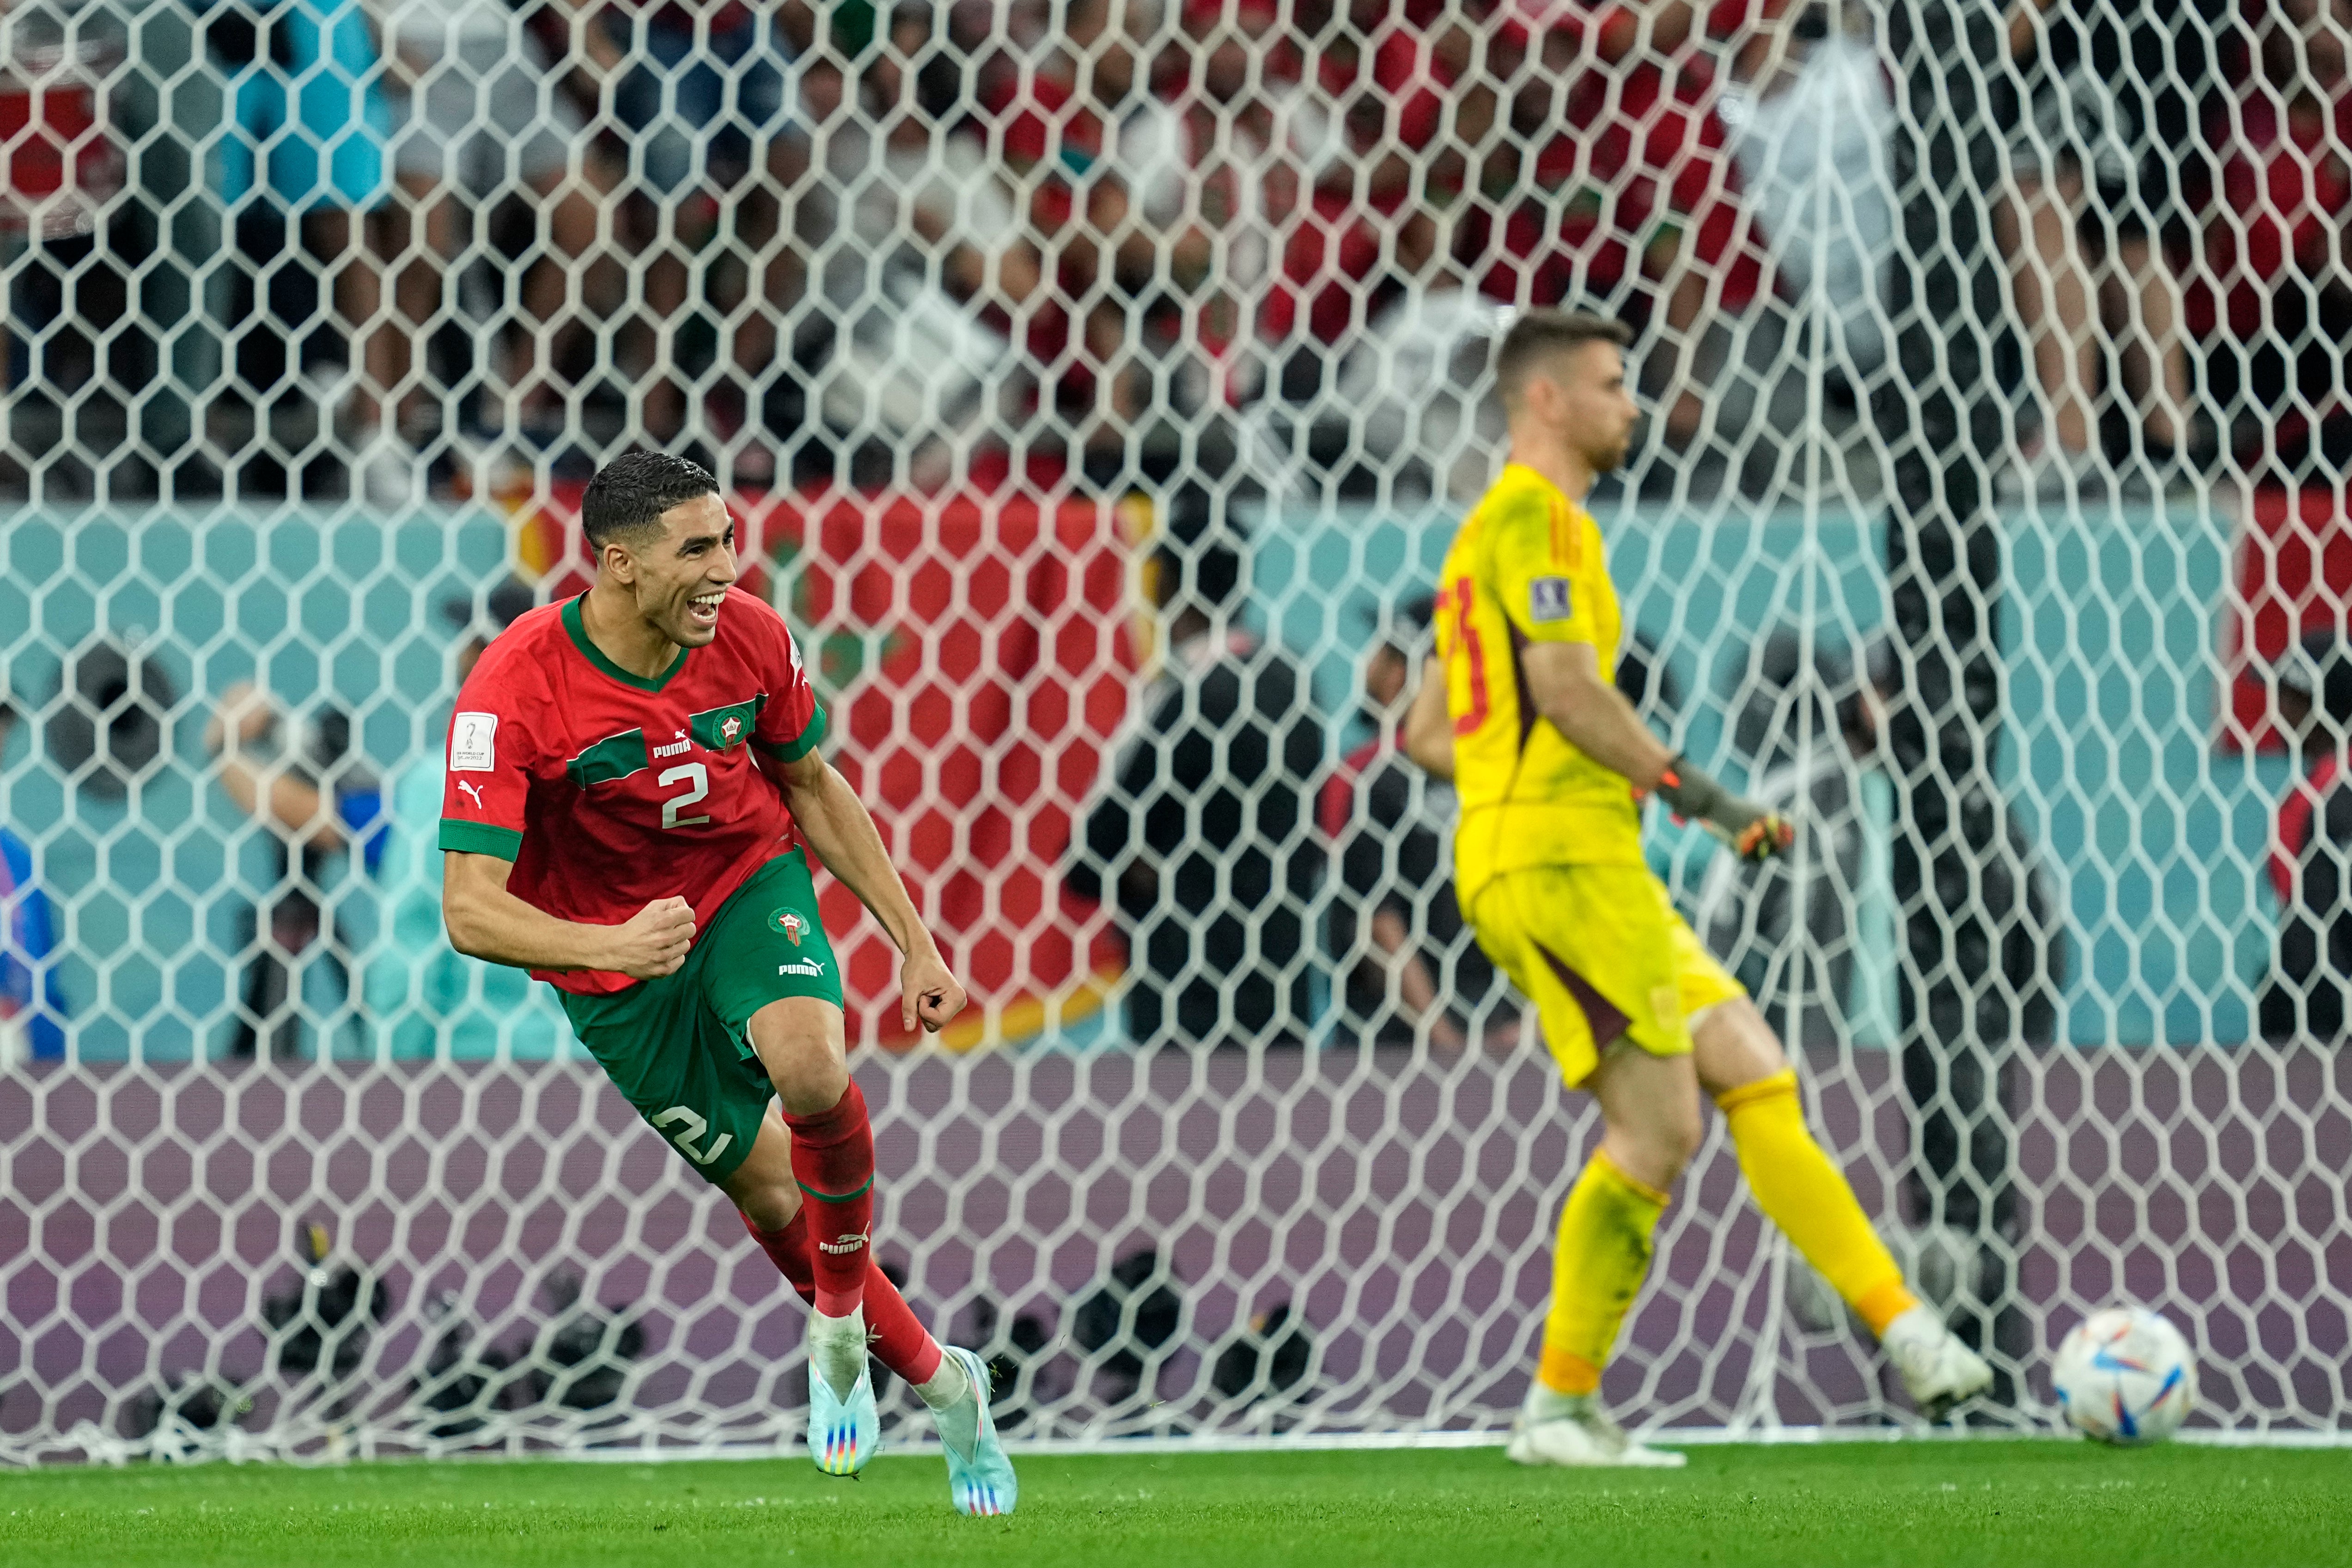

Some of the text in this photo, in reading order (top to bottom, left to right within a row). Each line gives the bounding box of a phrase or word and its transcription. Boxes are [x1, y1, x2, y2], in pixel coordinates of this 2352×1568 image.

[653, 739, 691, 758] PUMA
[658, 762, 710, 829] 2
[779, 964, 817, 977] PUMA
[652, 1105, 733, 1165] 2
[819, 1239, 863, 1254] PUMA
